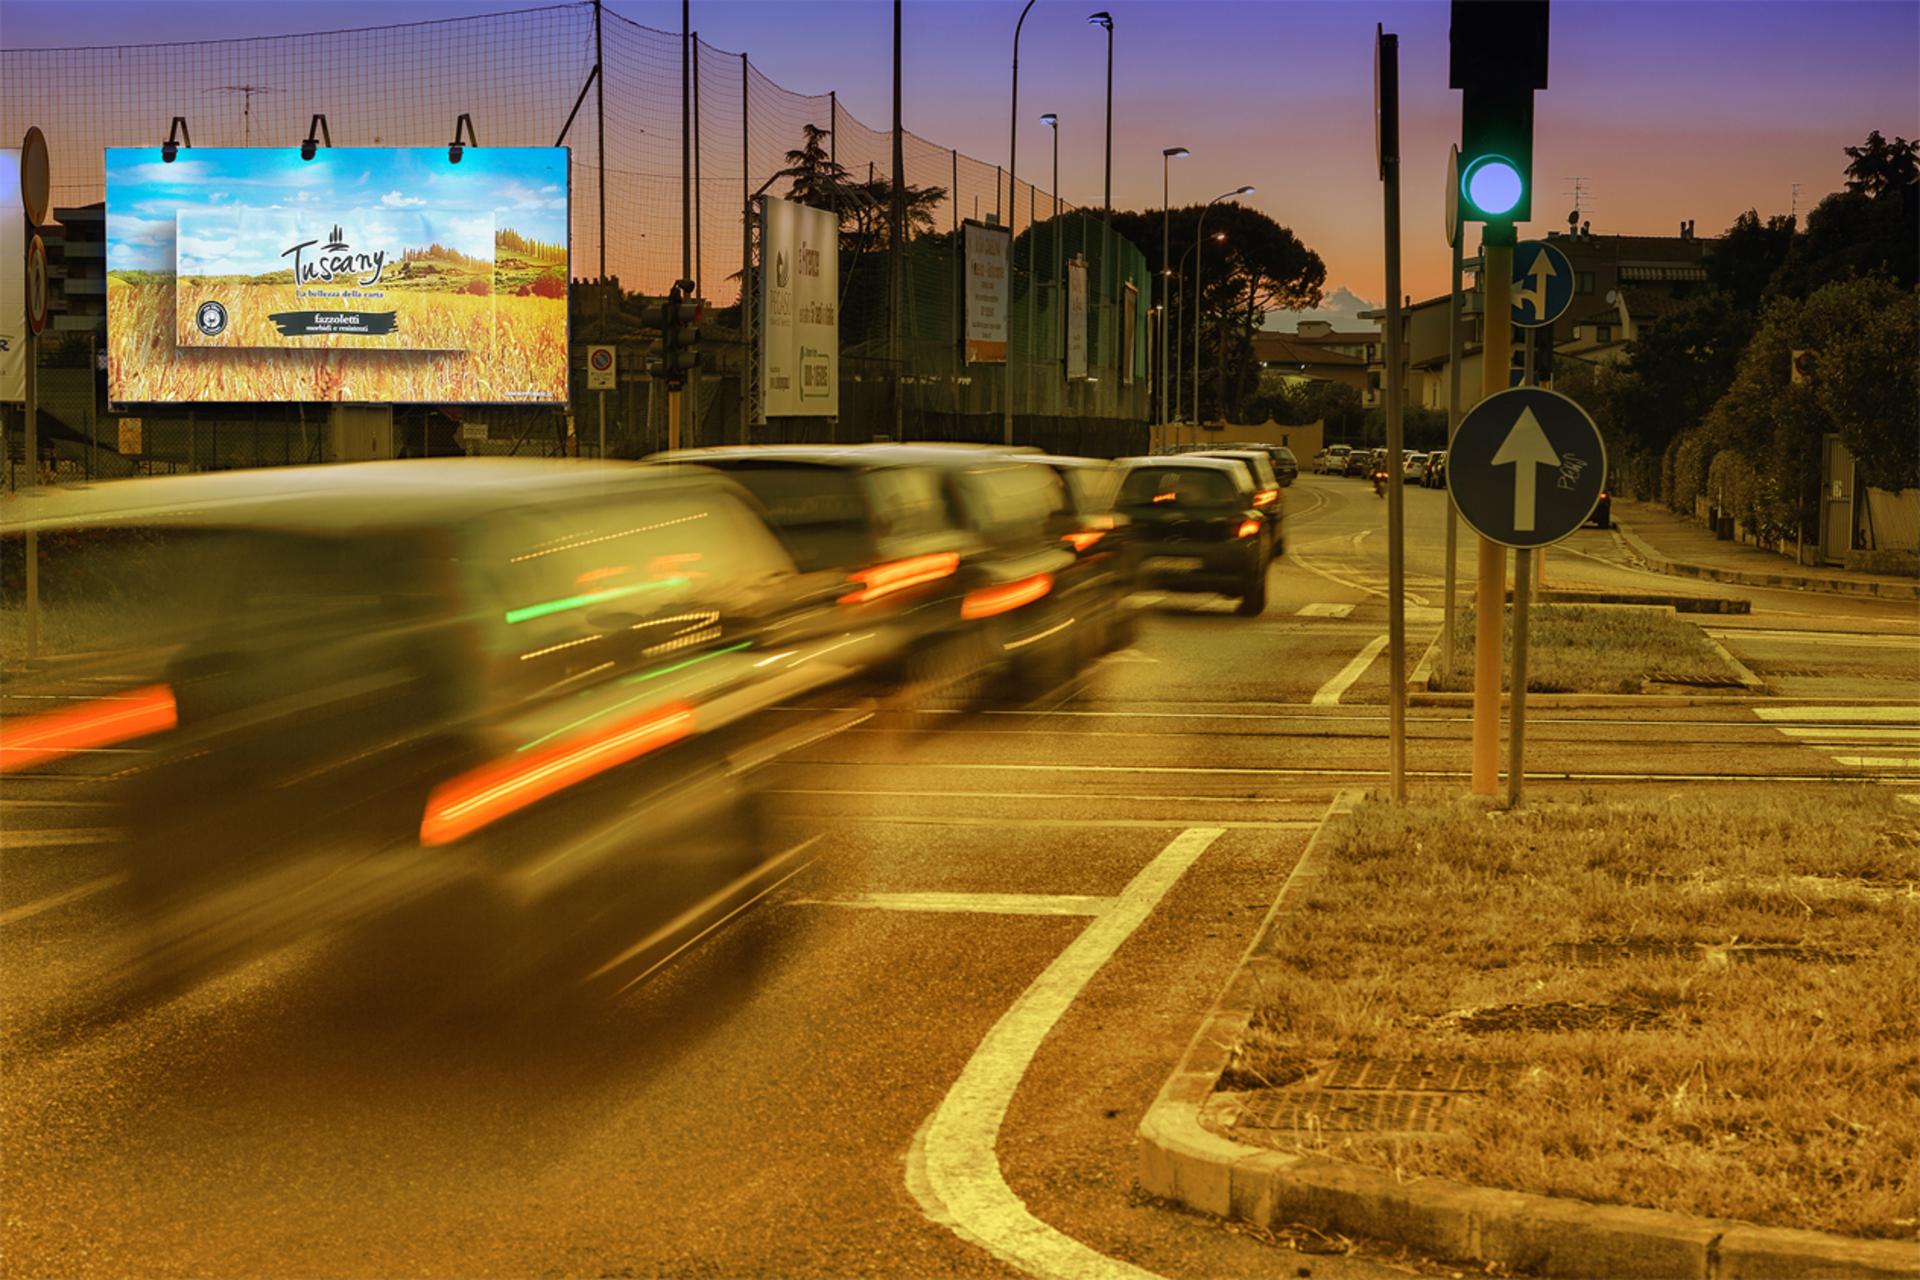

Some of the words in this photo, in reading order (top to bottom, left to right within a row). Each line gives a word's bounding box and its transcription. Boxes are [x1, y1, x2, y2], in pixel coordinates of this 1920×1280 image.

[281, 239, 384, 286] Tuscany
[342, 289, 362, 298] della
[314, 313, 360, 324] fazzoletti
